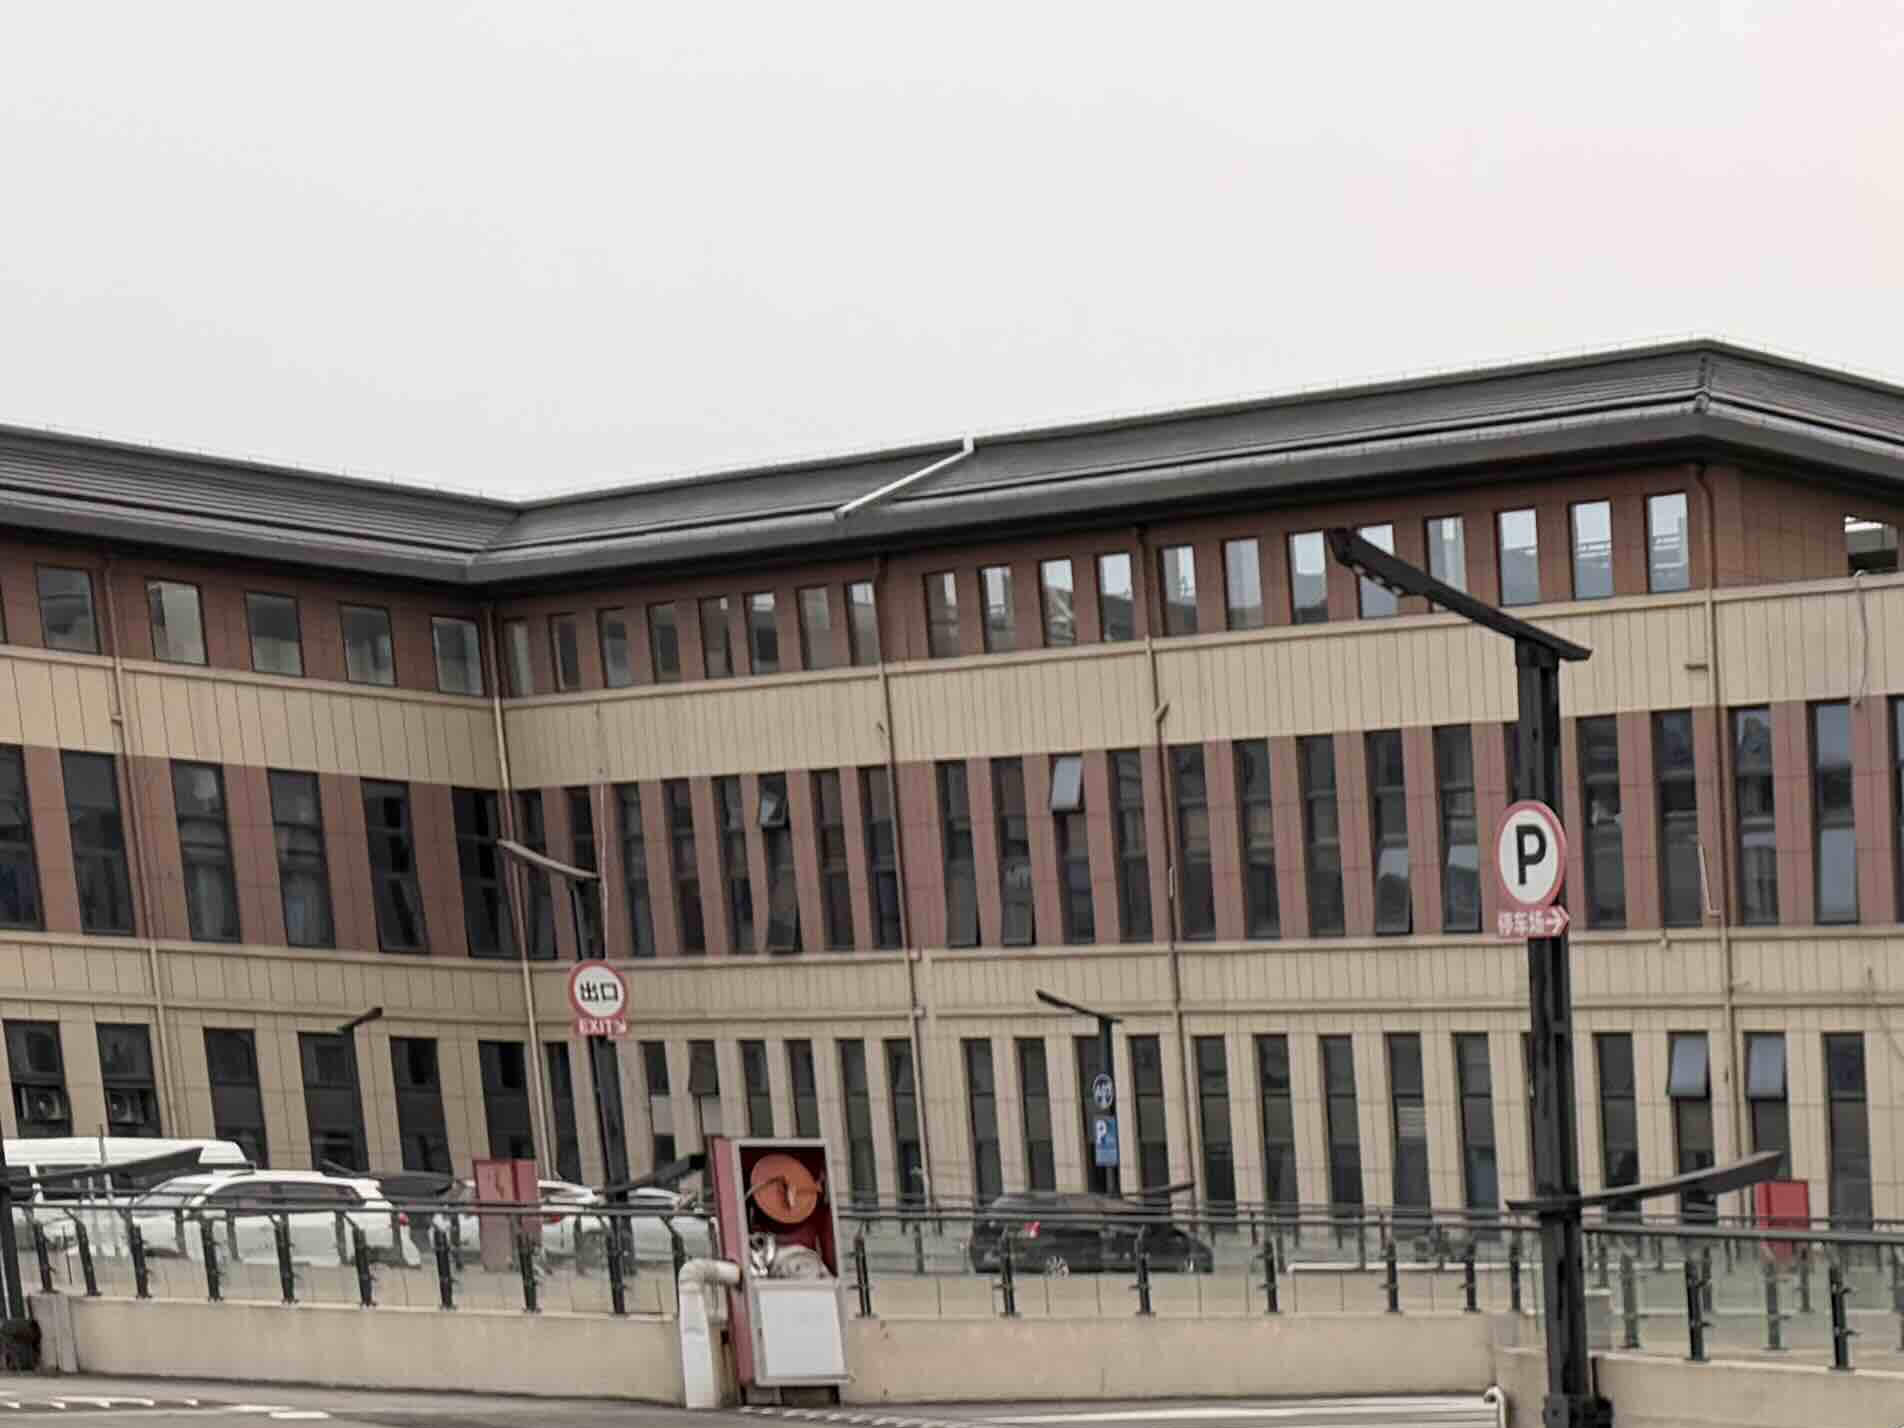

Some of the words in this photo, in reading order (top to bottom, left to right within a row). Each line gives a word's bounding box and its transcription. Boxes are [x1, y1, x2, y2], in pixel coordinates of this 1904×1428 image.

[1515, 823, 1547, 885] P
[579, 980, 619, 1002] 出口
[578, 1019, 613, 1034] EXIT
